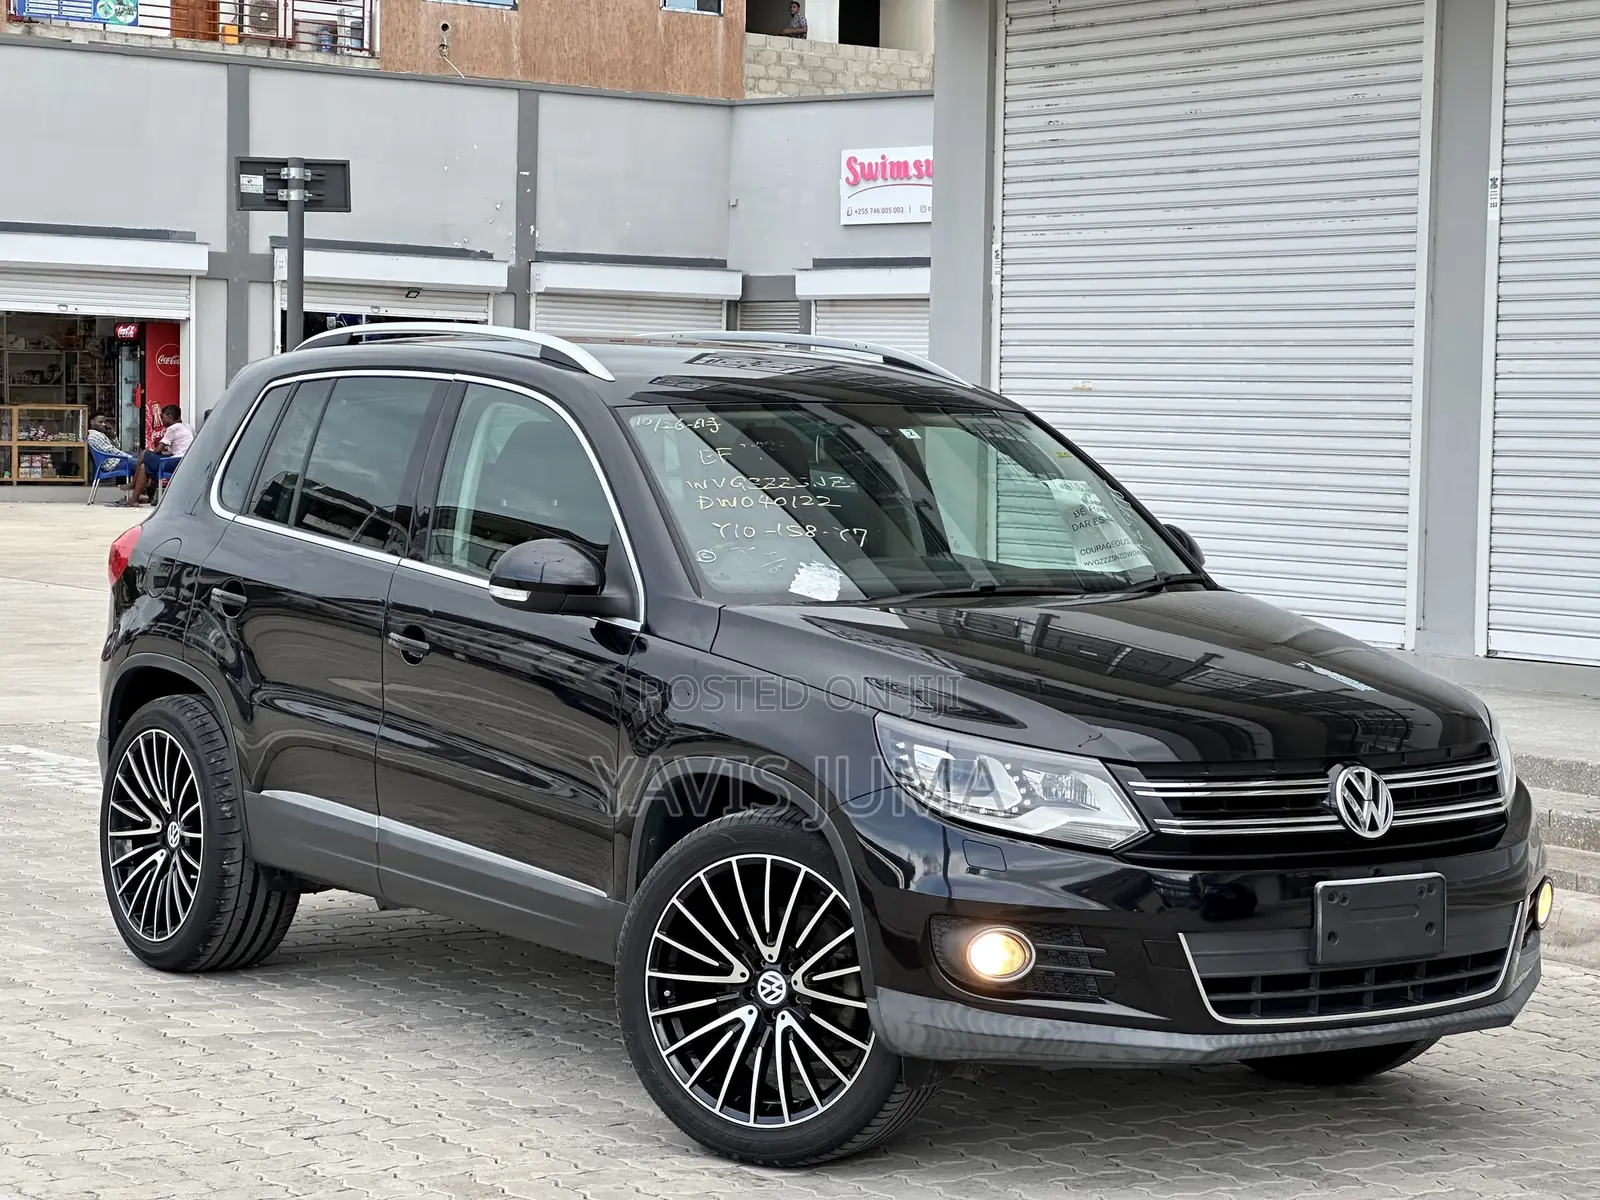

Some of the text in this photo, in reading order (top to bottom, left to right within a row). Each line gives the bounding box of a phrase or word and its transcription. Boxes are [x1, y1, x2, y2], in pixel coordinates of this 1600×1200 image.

[854, 207, 869, 215] +255
[893, 206, 904, 214] 003
[1071, 520, 1092, 532] DAR
[1093, 515, 1106, 526] ES
[1080, 538, 1131, 556] COURAGEOUS
